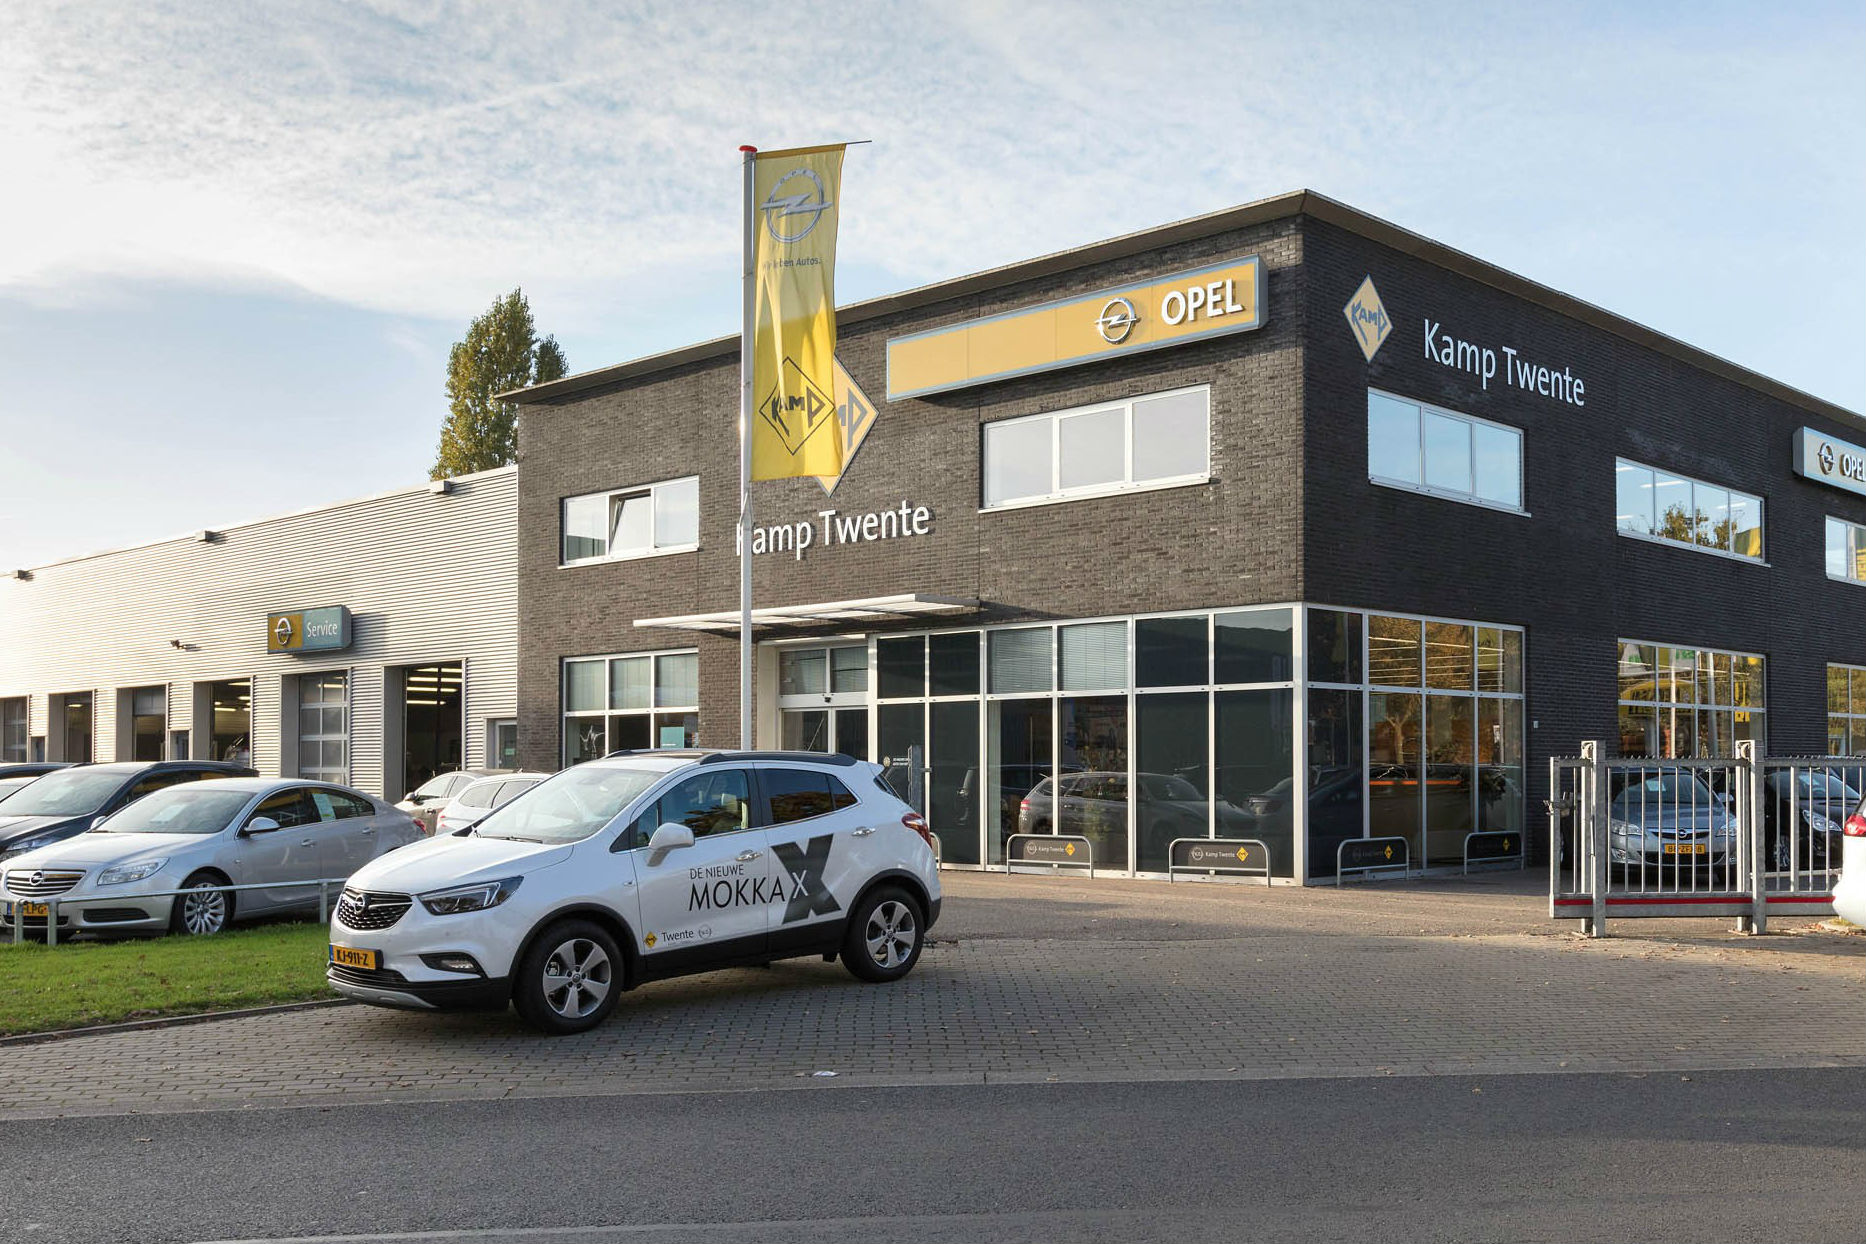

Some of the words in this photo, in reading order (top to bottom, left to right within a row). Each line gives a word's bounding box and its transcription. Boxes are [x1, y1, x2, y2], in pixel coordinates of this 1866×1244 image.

[1161, 278, 1244, 326] OPEL
[1350, 300, 1388, 346] KAMP
[1424, 318, 1496, 390] Kamp
[1502, 346, 1585, 407] Twente
[818, 500, 930, 546] Twente
[306, 620, 338, 638] Service
[689, 867, 703, 880] DE
[705, 863, 745, 879] NIEUWE
[688, 876, 786, 912] MOKKA
[661, 929, 694, 942] Twente
